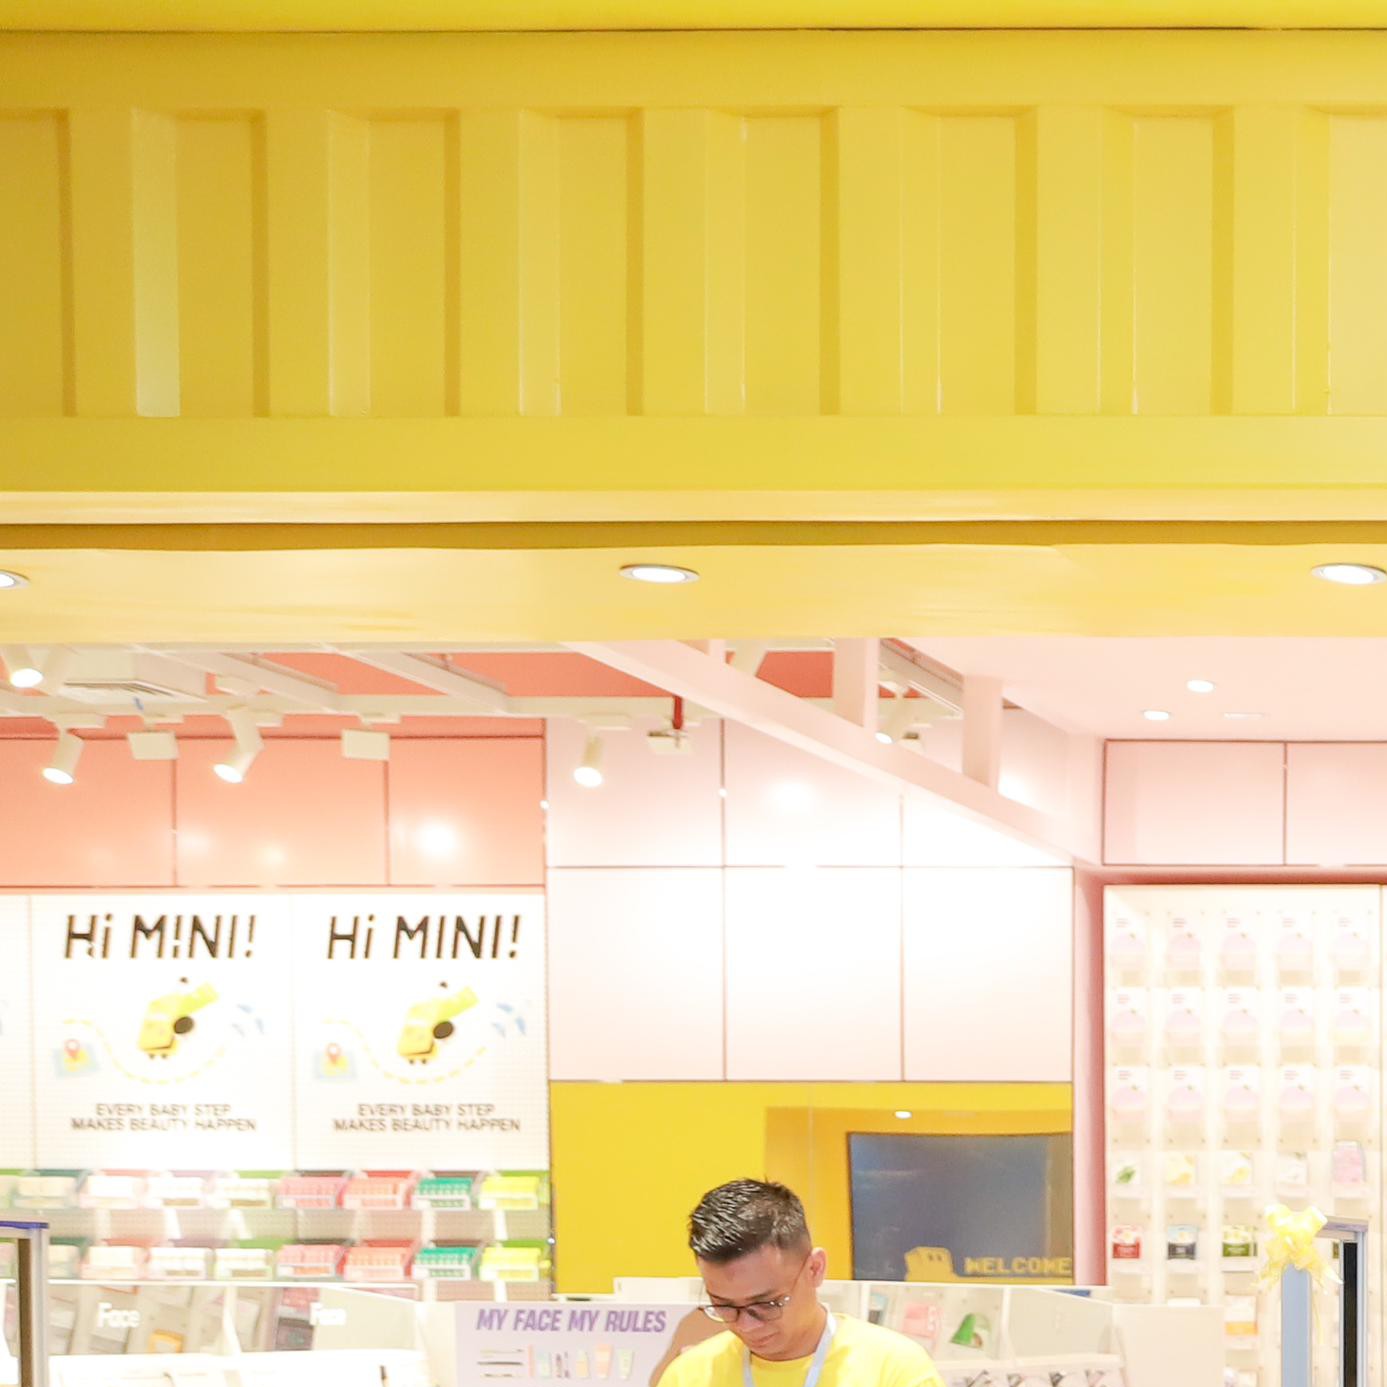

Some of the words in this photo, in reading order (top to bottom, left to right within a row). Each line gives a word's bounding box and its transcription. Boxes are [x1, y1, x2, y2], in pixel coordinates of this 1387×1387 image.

[64, 913, 113, 959] Hi
[327, 914, 375, 960] Hi
[393, 914, 521, 960] MINI!
[95, 1103, 144, 1116] EVERY
[150, 1104, 188, 1116] BABY
[194, 1104, 232, 1116] STEP
[358, 1103, 406, 1117] EVERY
[412, 1103, 451, 1117] BABY
[457, 1103, 495, 1117] STEP
[71, 1118, 125, 1130] MAKES
[130, 1118, 188, 1131] BEAUTY
[195, 1118, 256, 1131] HAPPEN
[333, 1118, 386, 1131] MAKES
[391, 1118, 451, 1131] BEAUTY
[457, 1118, 520, 1132] HAPPEN
[964, 1256, 1072, 1274] WELCOME
[476, 1309, 508, 1331] MY
[513, 1309, 563, 1332] FACE
[567, 1310, 600, 1332] MY
[605, 1310, 667, 1333] RULES
